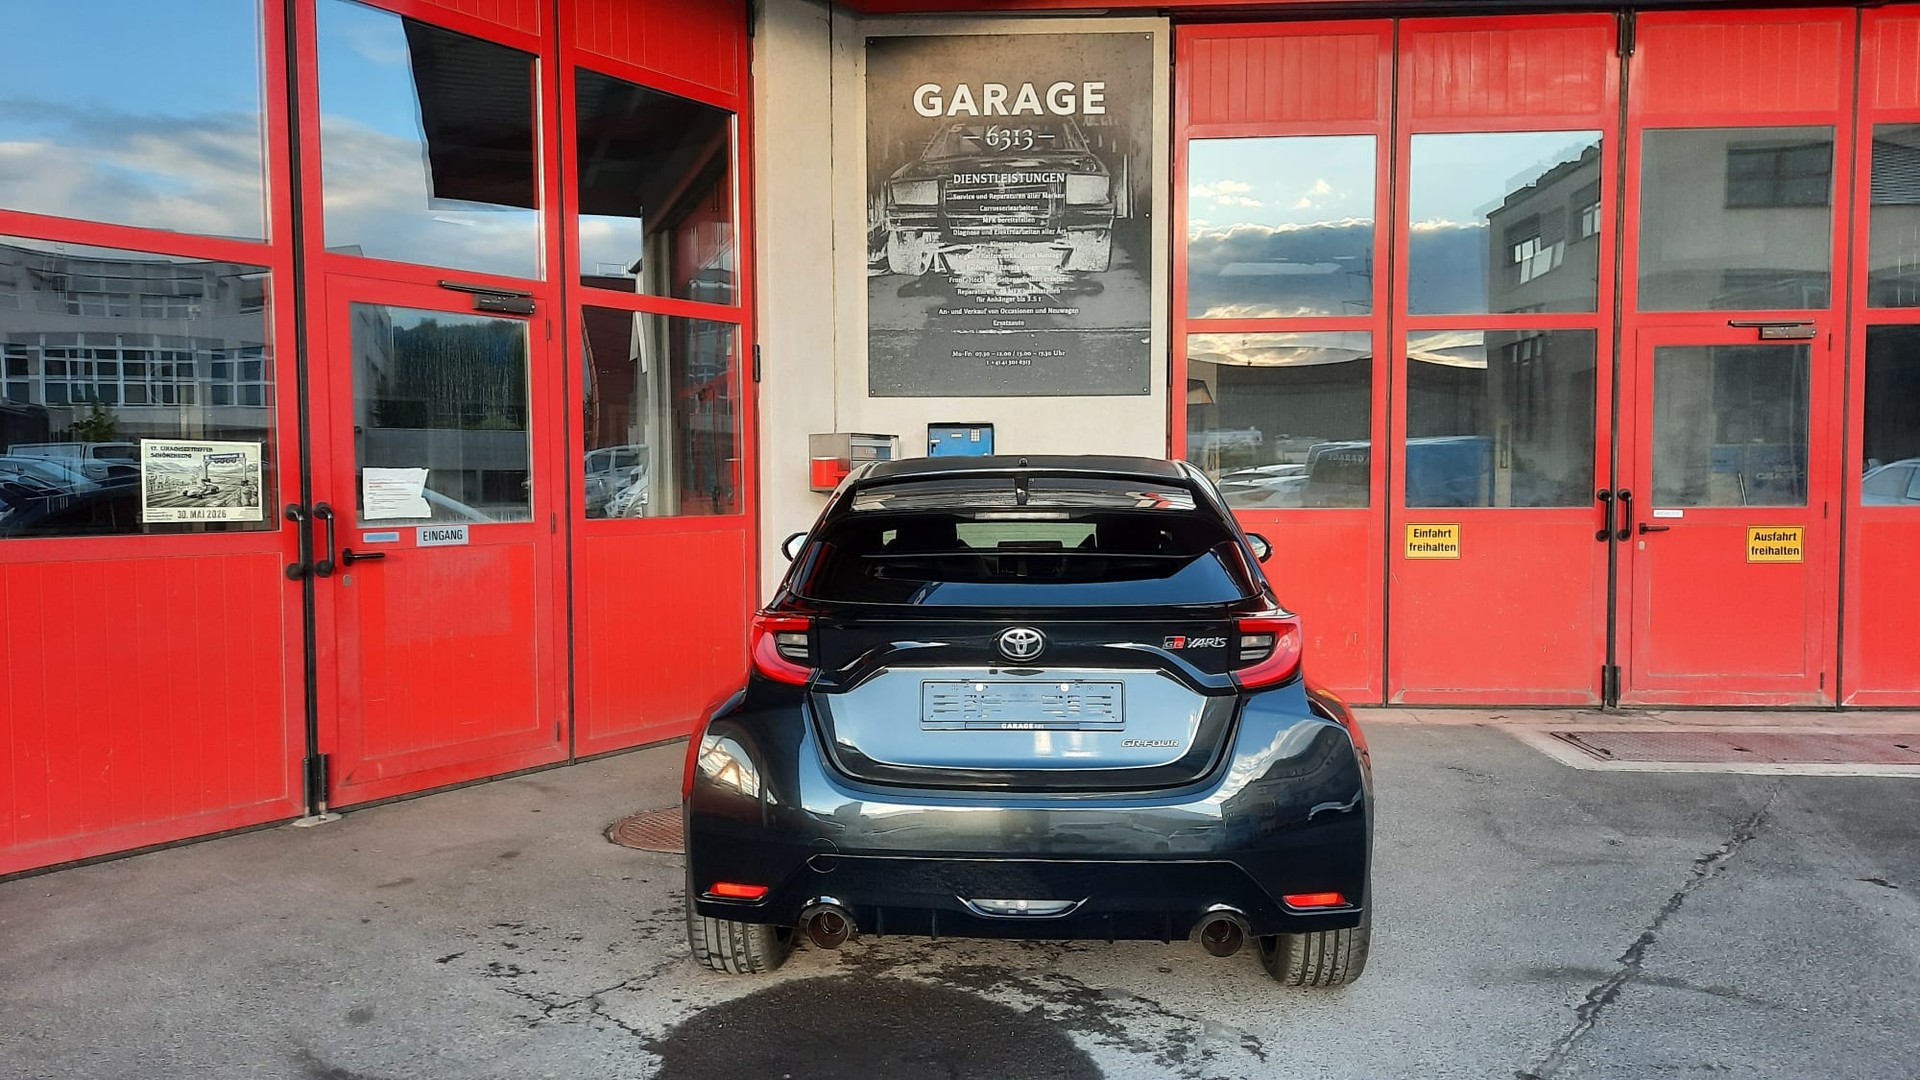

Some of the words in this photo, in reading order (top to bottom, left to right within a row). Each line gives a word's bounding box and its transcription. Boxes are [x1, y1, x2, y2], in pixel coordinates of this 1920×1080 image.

[913, 81, 1106, 117] GARAGE
[986, 124, 1034, 151] 6313
[953, 172, 1065, 184] DIENSTLEISTUNGEN
[989, 193, 1026, 201] Reparaturen
[953, 229, 980, 237] Diagnose
[1056, 227, 1066, 235] Art
[987, 296, 1016, 304] Anhänger
[177, 510, 188, 520] 30.
[190, 510, 205, 519] MAI
[207, 509, 227, 519] 2026
[423, 529, 463, 541] EINGANG
[1413, 528, 1451, 538] Einfahrt
[1754, 532, 1797, 541] Ausfahrt
[1409, 542, 1456, 552] freihalten
[1751, 546, 1799, 556] freihalten
[1187, 637, 1228, 648] YARIS
[1121, 739, 1179, 747] GR-FOUR
